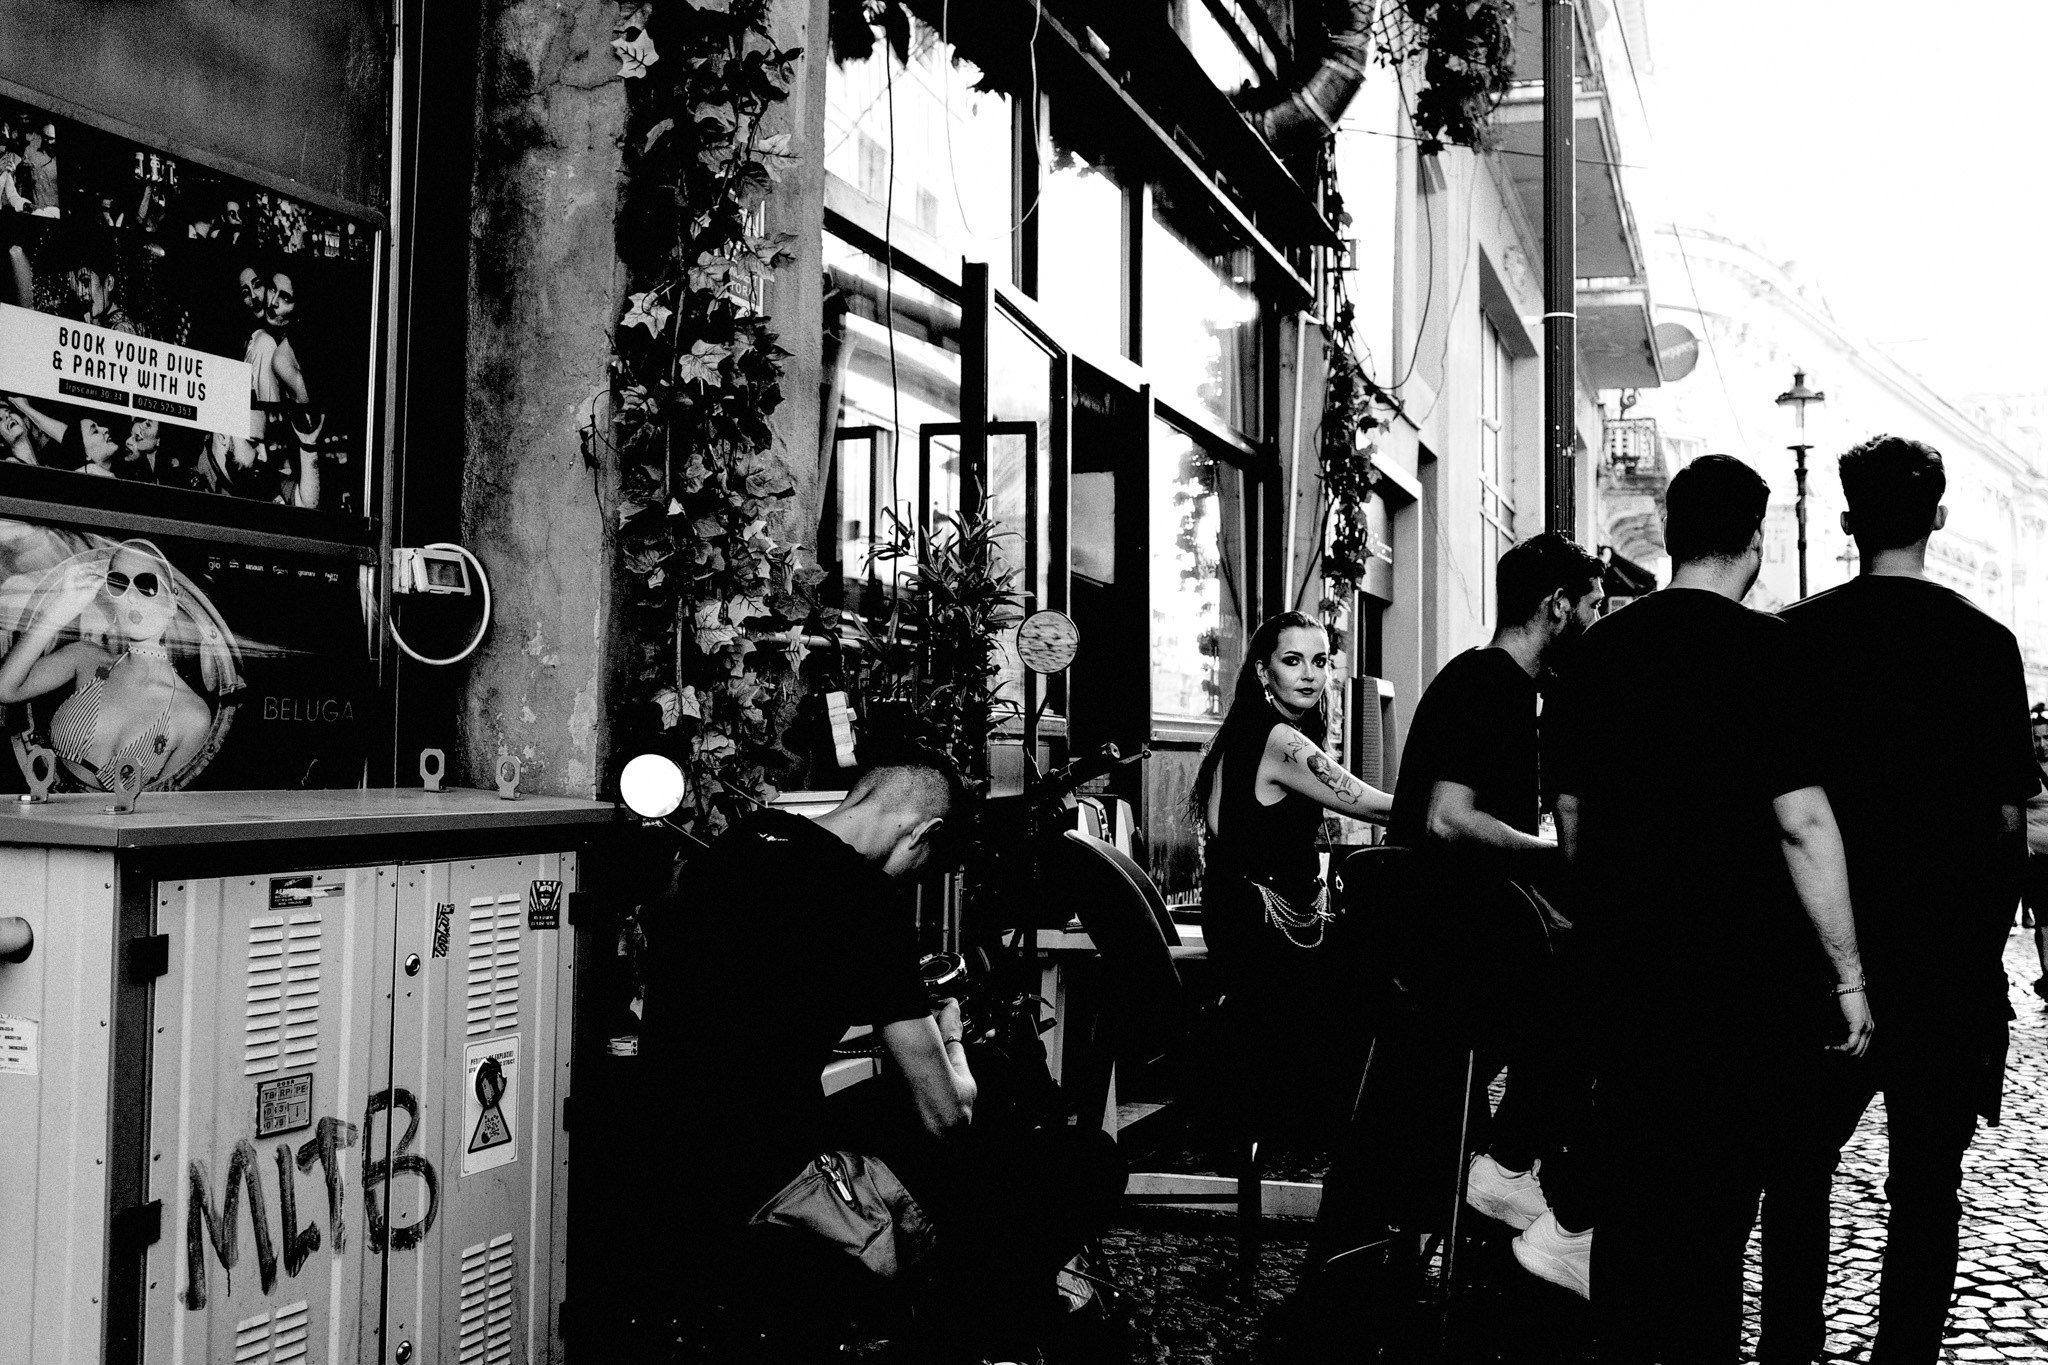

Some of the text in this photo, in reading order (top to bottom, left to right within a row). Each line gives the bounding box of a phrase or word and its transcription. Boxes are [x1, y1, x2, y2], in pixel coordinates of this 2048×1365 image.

[52, 350, 206, 401] & PARTY WITH US
[59, 327, 203, 378] BOOK YOUR DIVE
[263, 696, 354, 722] BELUGA
